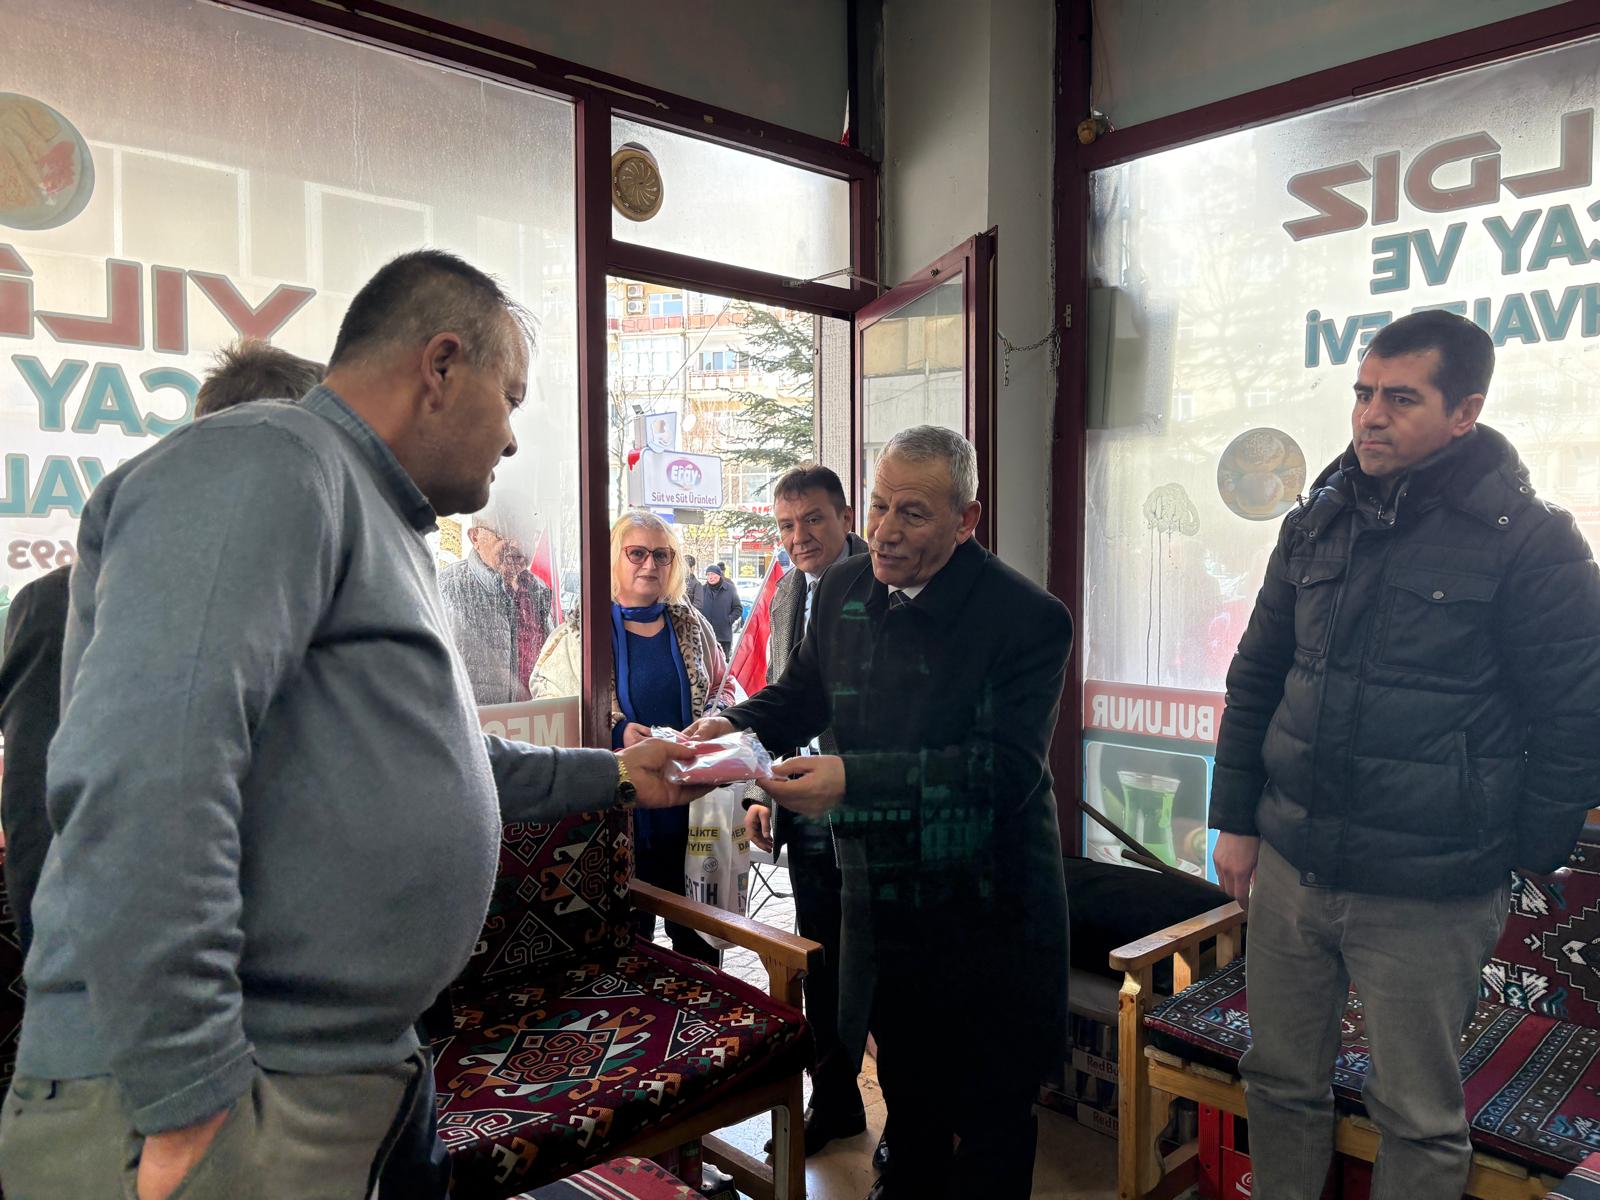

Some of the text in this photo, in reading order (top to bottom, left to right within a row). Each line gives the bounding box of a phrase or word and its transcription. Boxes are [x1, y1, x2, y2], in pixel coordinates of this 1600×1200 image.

[651, 491, 717, 505] Süt ve Süt Ürünleri
[688, 827, 718, 838] LİKTE
